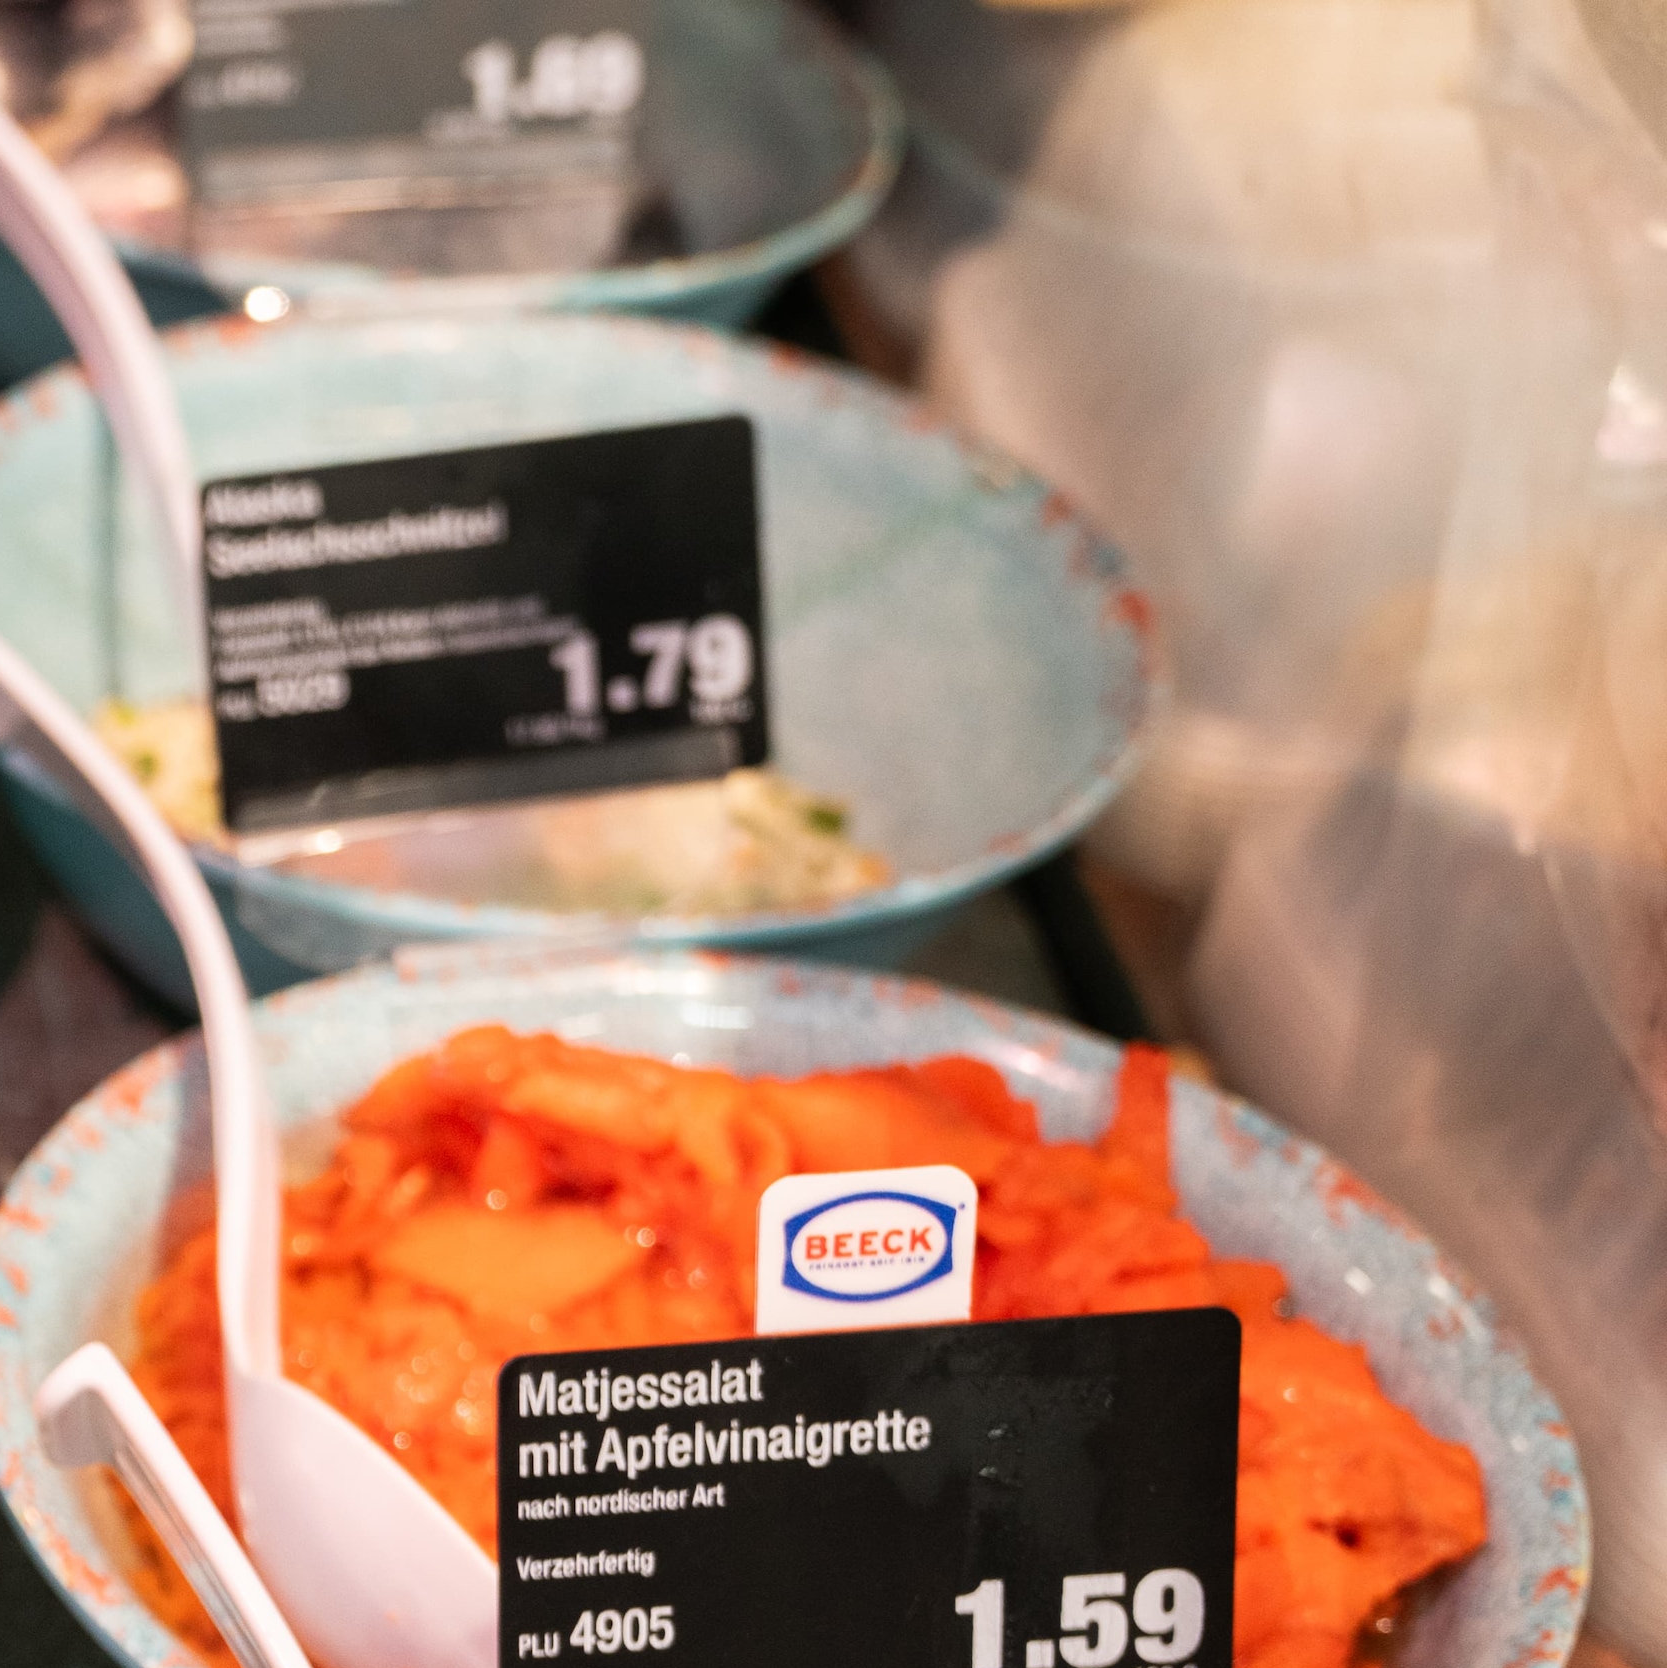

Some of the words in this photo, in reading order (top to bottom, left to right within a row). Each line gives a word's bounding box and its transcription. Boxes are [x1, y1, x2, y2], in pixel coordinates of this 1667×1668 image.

[548, 614, 753, 717] 1.79
[804, 1227, 931, 1260] BEECK
[518, 1359, 762, 1420] Matjessalat
[518, 1431, 587, 1477] mit
[596, 1410, 930, 1477] Apfelvinaigrette
[517, 1493, 570, 1520] nach
[574, 1487, 687, 1515] nordischer
[691, 1482, 724, 1507] Art
[516, 1549, 655, 1580] Verzehrfertig
[517, 1631, 560, 1658] PLU
[569, 1605, 674, 1653] 4905
